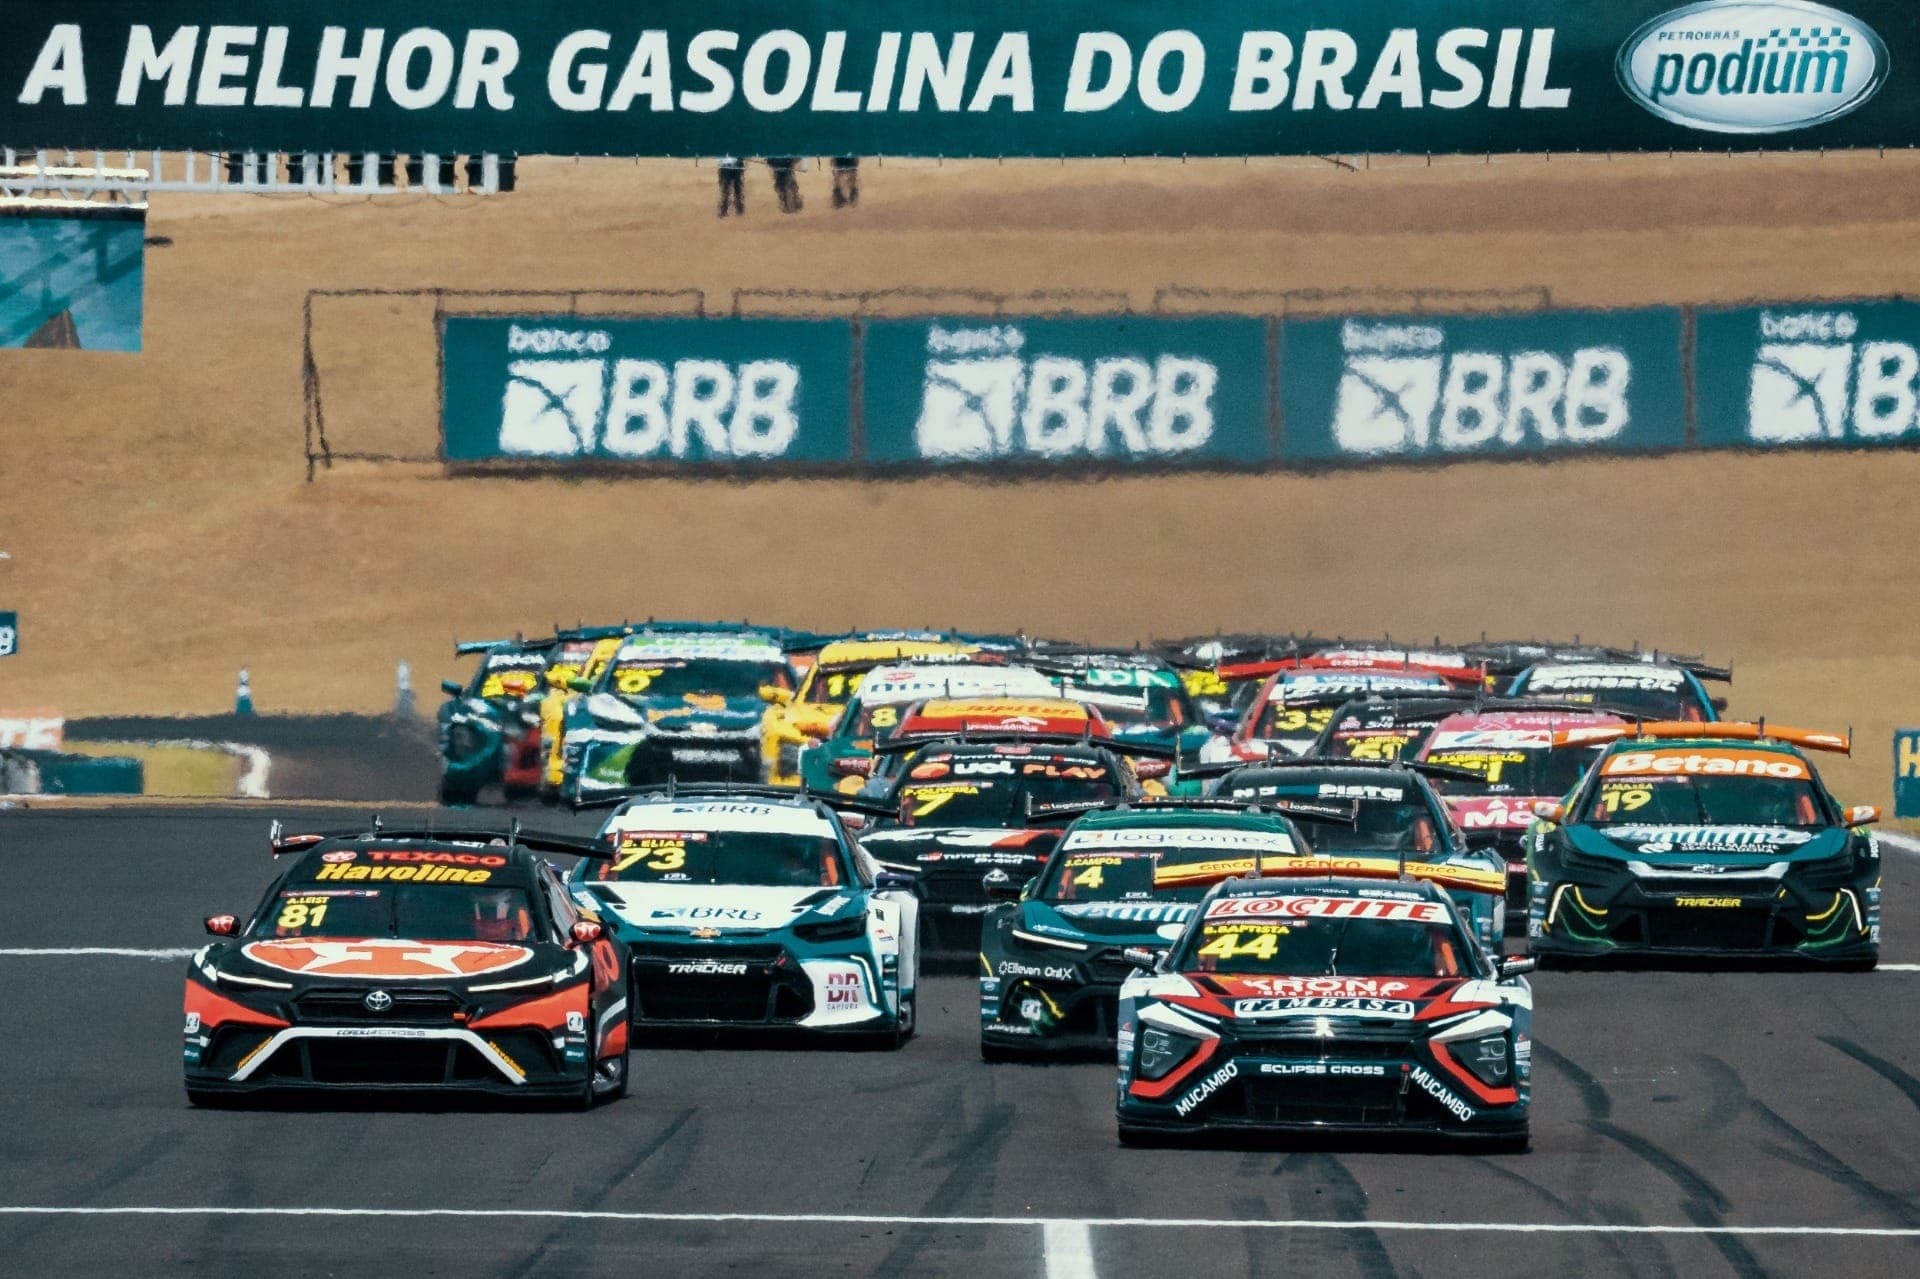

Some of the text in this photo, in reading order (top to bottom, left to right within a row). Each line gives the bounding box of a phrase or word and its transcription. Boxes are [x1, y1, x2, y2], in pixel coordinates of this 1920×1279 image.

[1658, 30, 1740, 41] PETROBRAS
[18, 23, 1571, 113] A MELHOR GASOLINA DO BRASIL
[1650, 38, 1848, 103] podium
[601, 357, 799, 458] BRB
[1021, 354, 1218, 457] BRB
[1438, 346, 1632, 451] BRB
[953, 760, 1016, 775] UOL
[1608, 753, 1803, 779] Betano
[707, 805, 772, 815] BRB
[912, 793, 955, 816] 7
[1601, 789, 1652, 813] 19
[1112, 830, 1282, 846] logcomex
[367, 850, 507, 866] TEXACO
[610, 846, 687, 872] 73
[315, 862, 492, 884] Havoline
[1073, 865, 1104, 889] 4
[690, 907, 762, 921] BRB
[1209, 897, 1439, 921] LOCTITE
[1675, 897, 1742, 908] TRACKER
[277, 904, 328, 928] 81
[1198, 933, 1279, 960] 44
[668, 964, 748, 975] TRACKER
[1240, 997, 1408, 1013] TAMBASA
[1260, 1064, 1385, 1075] ECLIPSE CROSS
[1174, 1060, 1239, 1117] MUCAMBO
[1410, 1066, 1474, 1122] MUCAMBO
